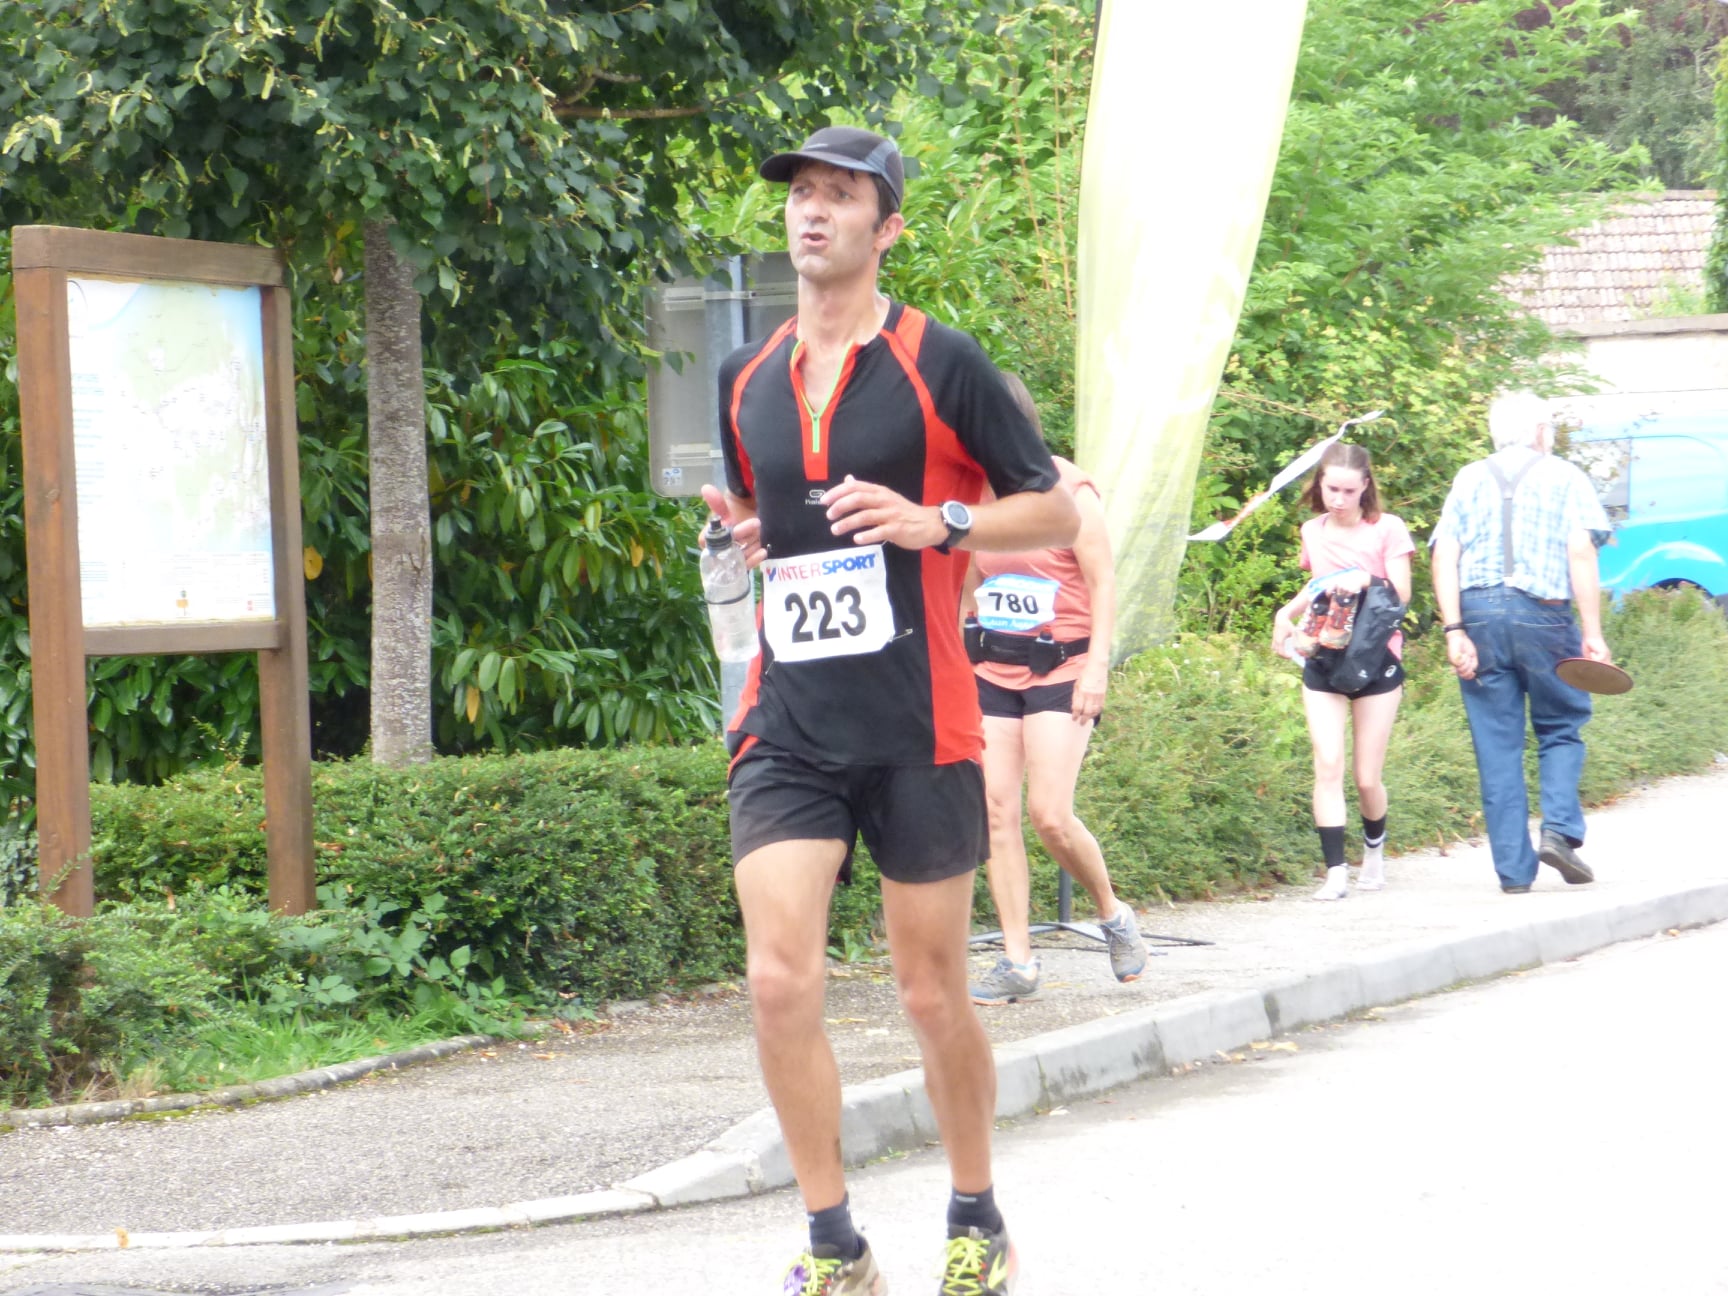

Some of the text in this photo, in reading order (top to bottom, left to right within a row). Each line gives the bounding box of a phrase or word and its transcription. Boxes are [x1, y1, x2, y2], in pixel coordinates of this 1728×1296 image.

[777, 553, 876, 581] INTERSPORT
[785, 585, 866, 643] 223
[988, 592, 1039, 614] 780
